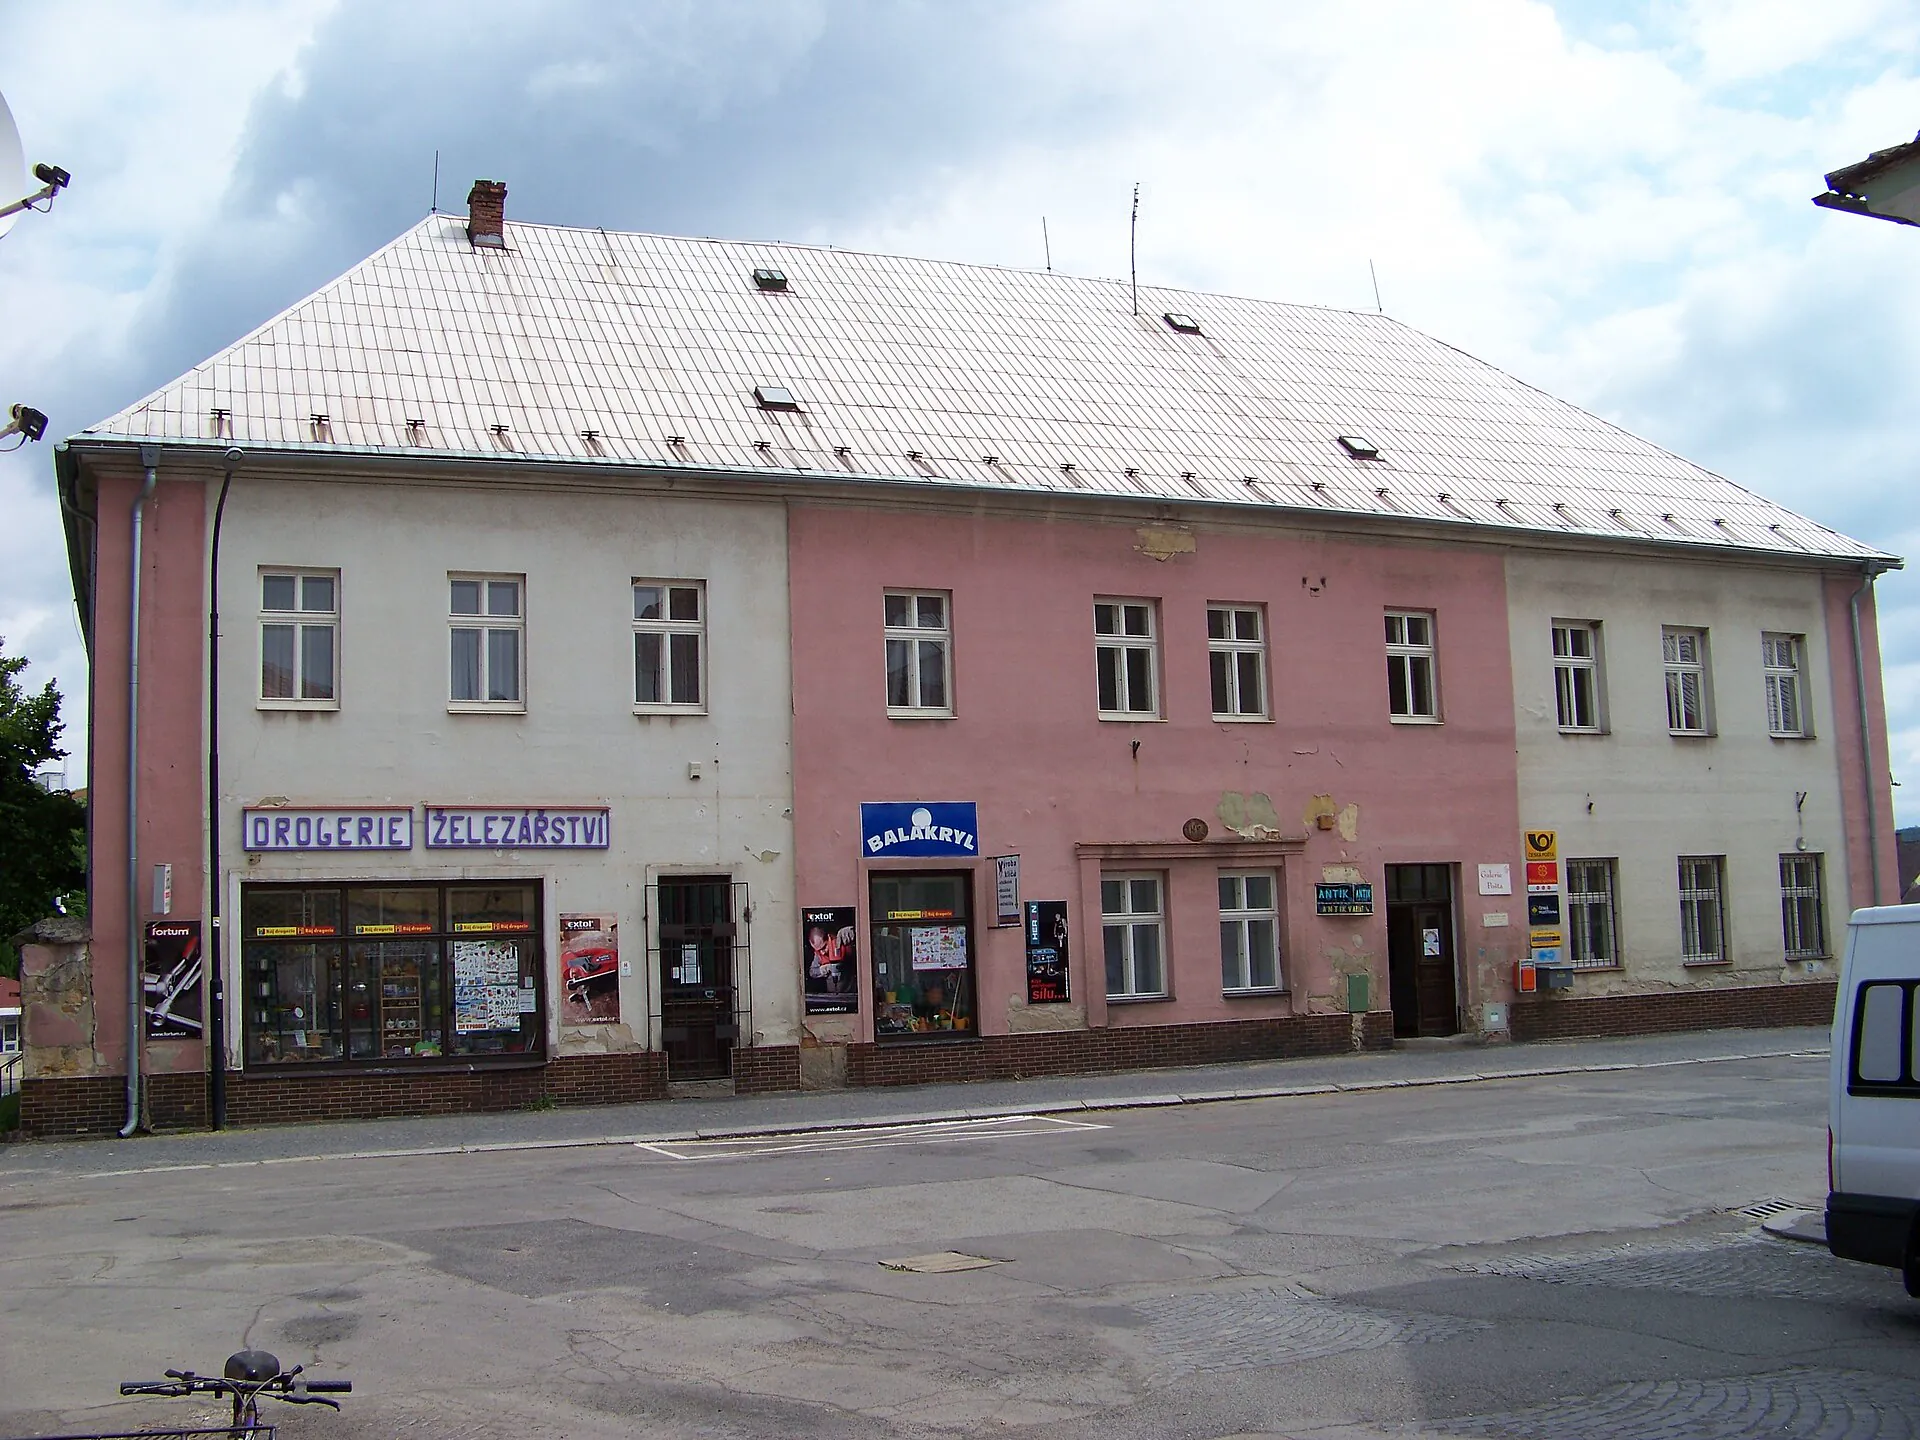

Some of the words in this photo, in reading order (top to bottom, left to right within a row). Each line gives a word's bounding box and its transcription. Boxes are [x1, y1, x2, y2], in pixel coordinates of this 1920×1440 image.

[254, 817, 403, 846] DROGERIE
[433, 809, 607, 844] ŽELEZÁŘSTVÍ
[867, 825, 975, 853] BALAKRYL
[1318, 889, 1349, 899] ANTIK
[1355, 888, 1371, 899] ANTIK
[567, 920, 594, 928] extol
[152, 927, 190, 936] fortum
